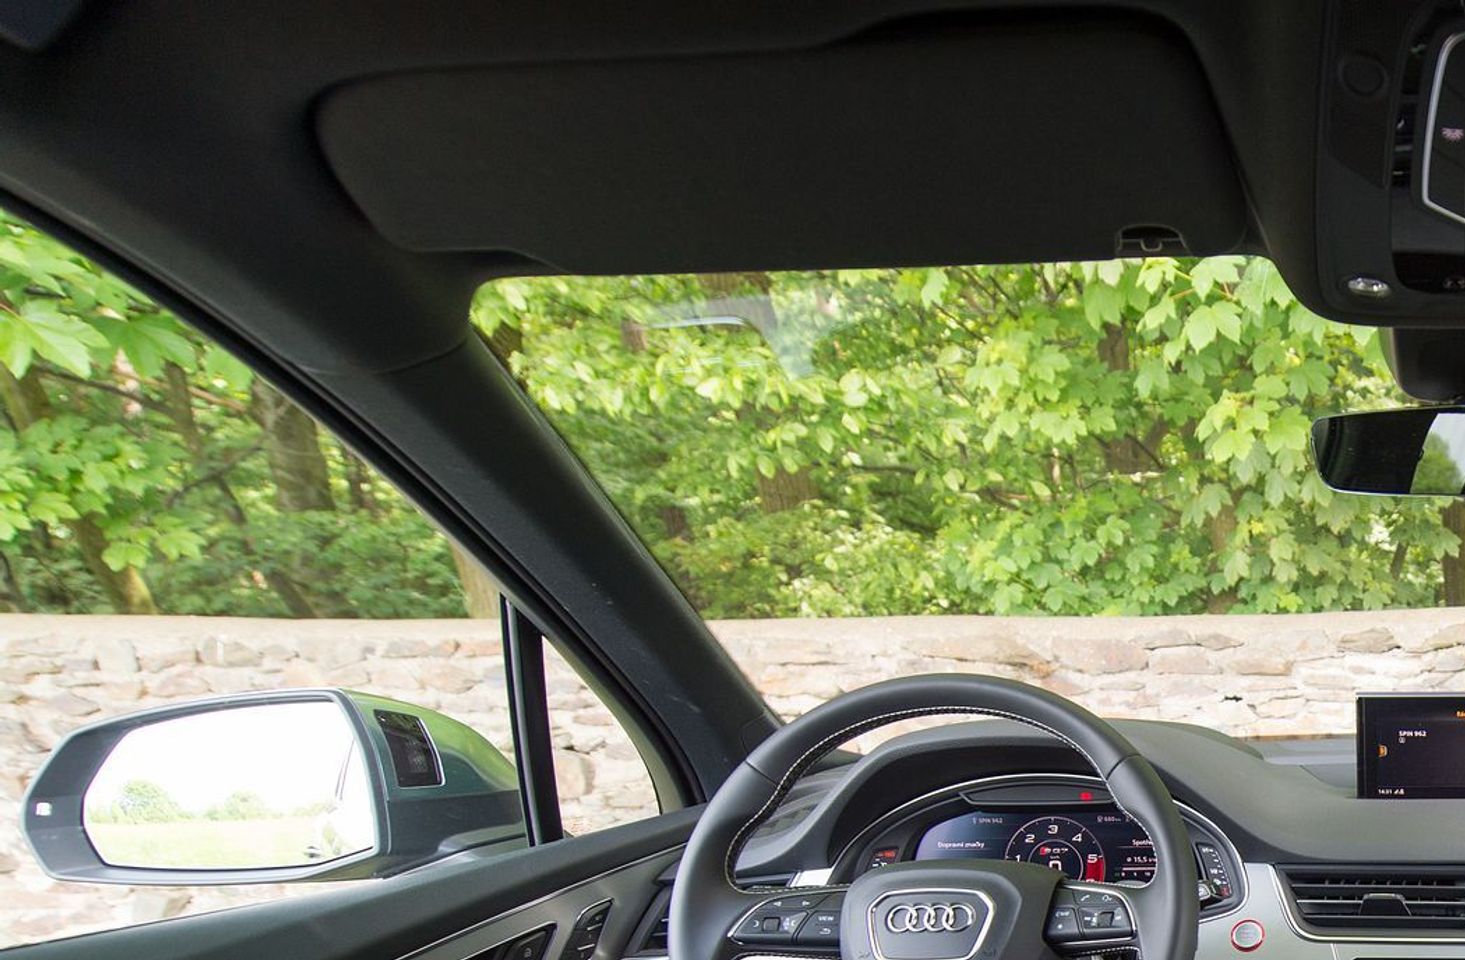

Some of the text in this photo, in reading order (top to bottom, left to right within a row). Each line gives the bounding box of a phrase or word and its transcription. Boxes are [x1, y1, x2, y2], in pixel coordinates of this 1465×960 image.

[1048, 825, 1058, 834] 3
[1025, 834, 1035, 843] 2
[1072, 833, 1082, 843] 4
[1015, 854, 1021, 863] 1
[1088, 854, 1098, 863] 5
